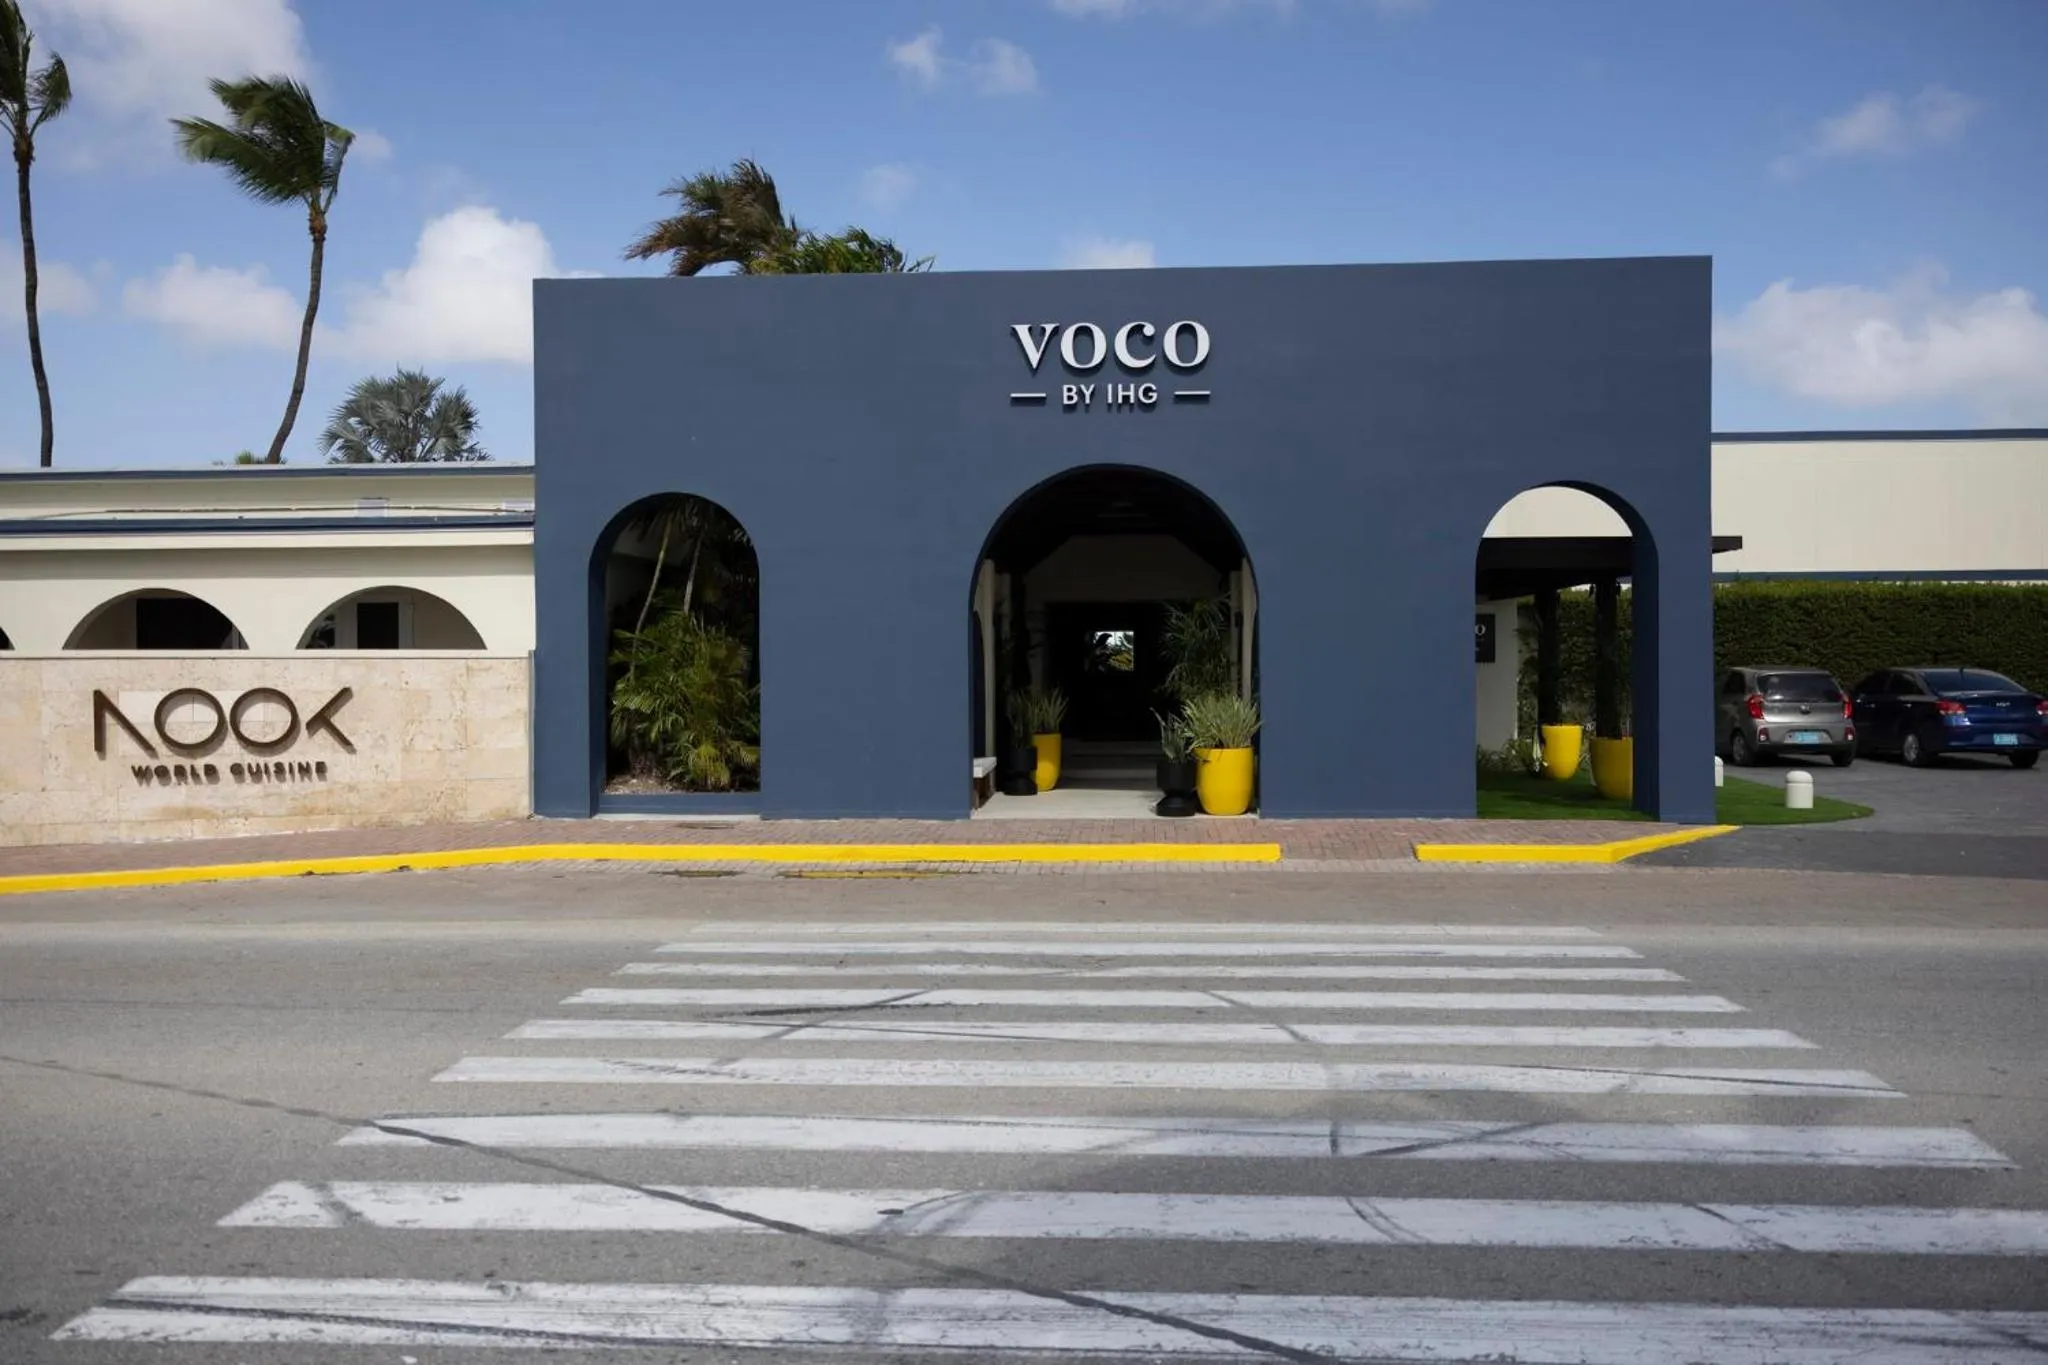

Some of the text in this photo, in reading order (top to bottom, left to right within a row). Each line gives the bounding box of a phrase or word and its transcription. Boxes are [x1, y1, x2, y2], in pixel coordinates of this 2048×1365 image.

[1062, 382, 1159, 405] BY IHG
[93, 687, 355, 755] NOOK
[131, 761, 327, 783] WORLD CUISINE
